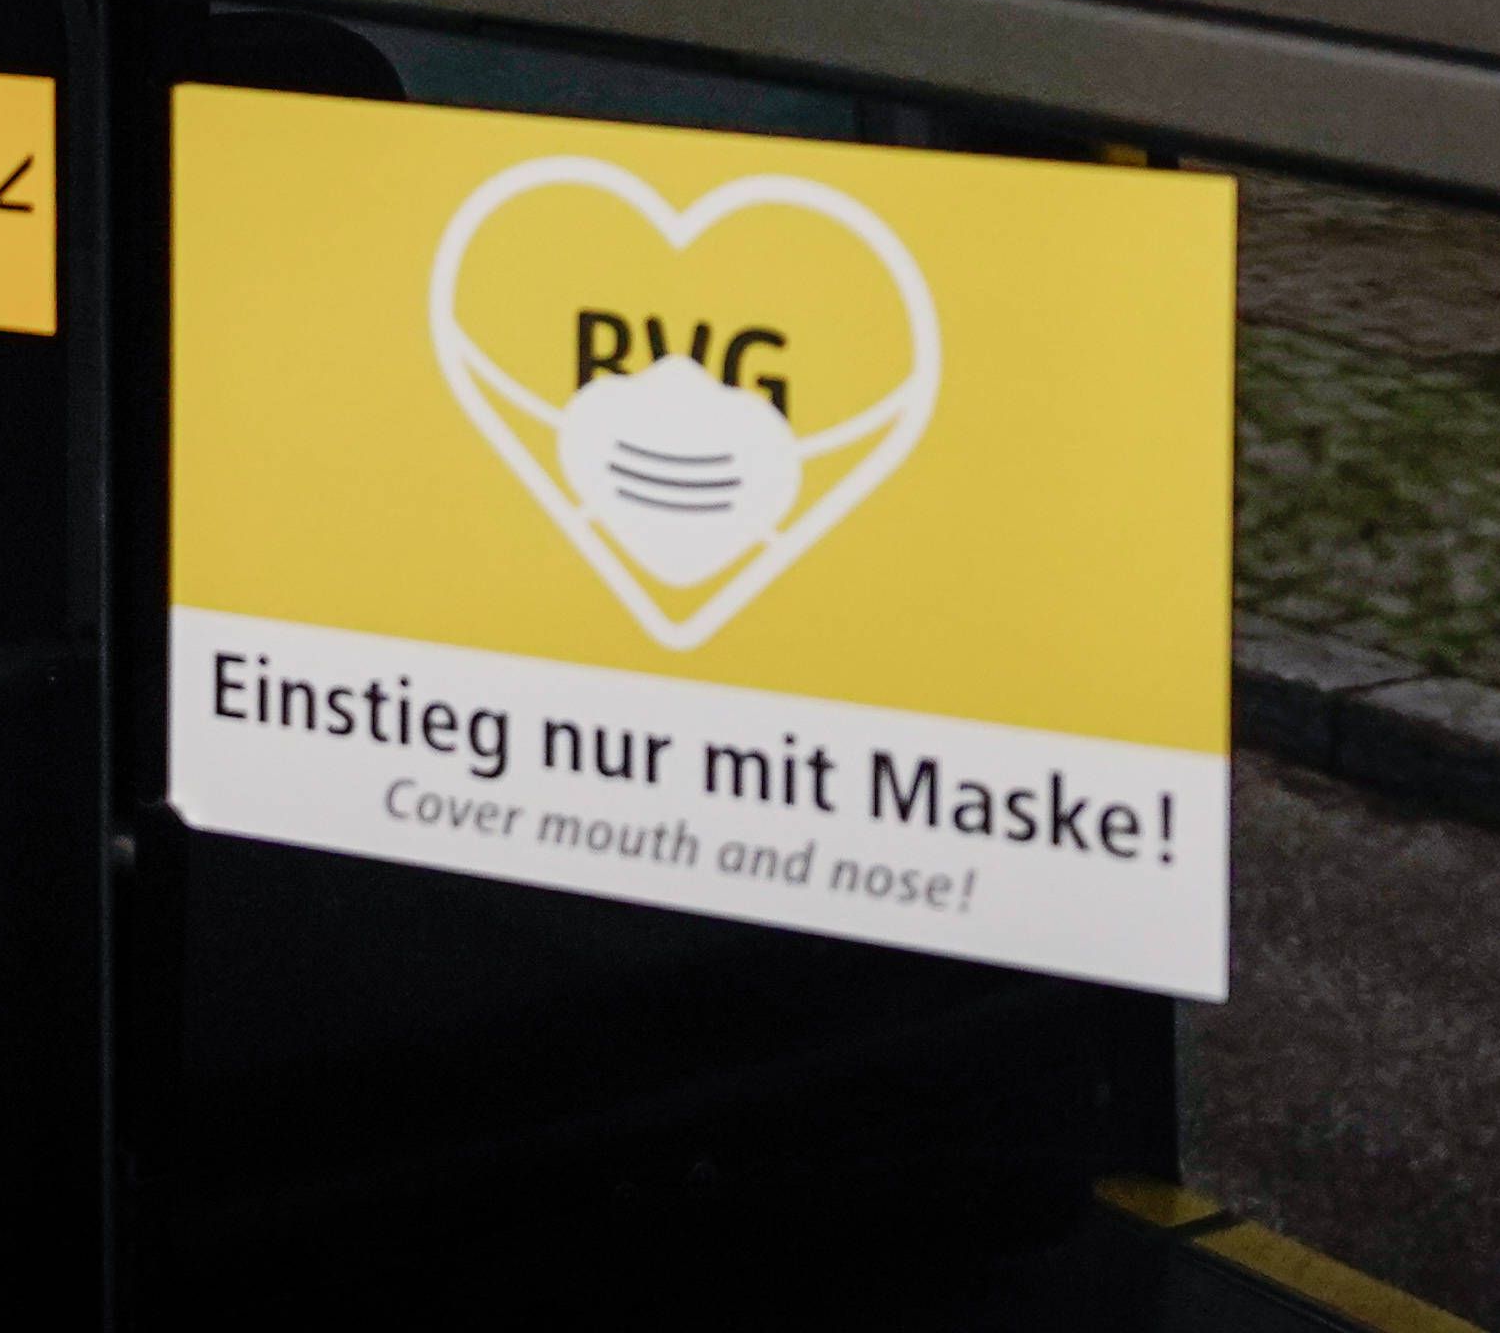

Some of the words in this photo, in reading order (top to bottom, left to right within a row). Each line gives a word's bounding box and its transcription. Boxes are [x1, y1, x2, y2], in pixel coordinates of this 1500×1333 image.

[213, 649, 510, 780] Einstieg
[542, 716, 673, 786] nur
[704, 731, 836, 815] mit
[870, 749, 1175, 865] Maske!
[384, 777, 526, 836] Cover
[536, 811, 699, 870] mouth
[716, 838, 818, 886] and
[828, 856, 978, 915] nose!
